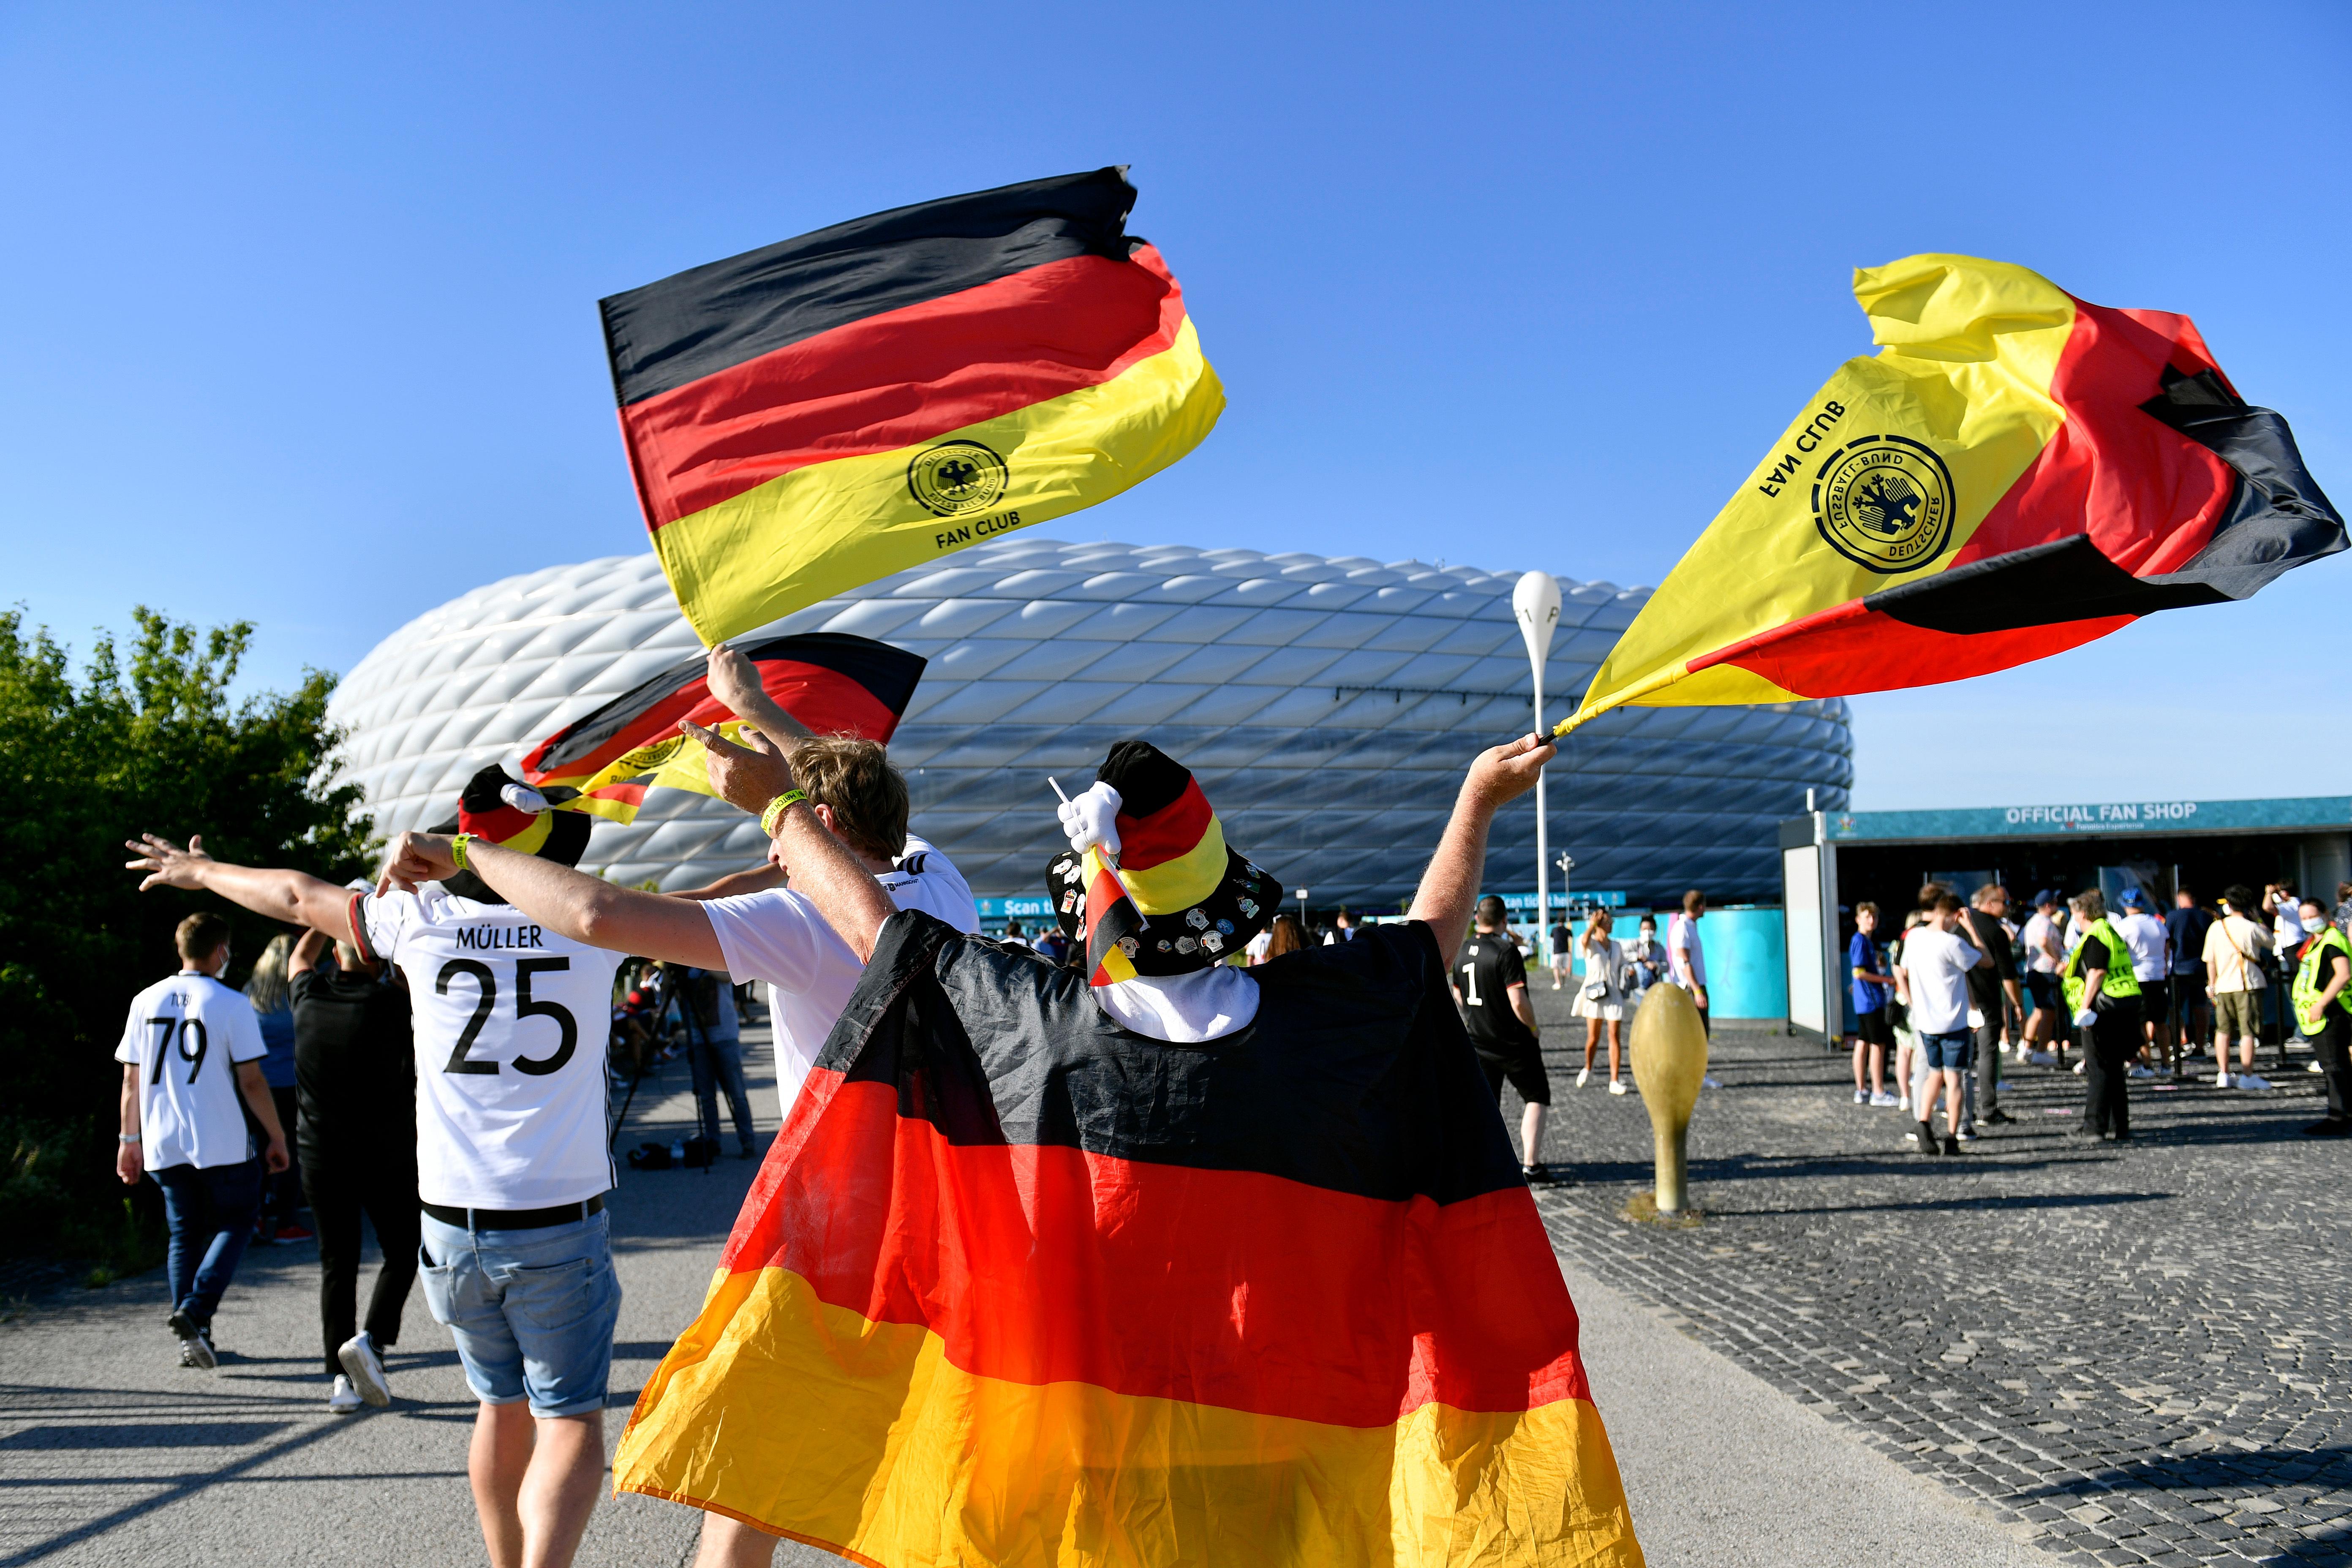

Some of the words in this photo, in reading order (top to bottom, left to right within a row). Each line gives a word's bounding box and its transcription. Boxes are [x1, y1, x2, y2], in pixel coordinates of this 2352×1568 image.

[936, 526, 971, 549] FAN
[975, 511, 1020, 535] CLUB
[769, 807, 776, 815] 12
[775, 793, 796, 808] MATCH
[2007, 805, 2094, 824] OFFICIAL
[2100, 804, 2137, 821] FAN
[2143, 802, 2197, 819] SHOP
[1004, 900, 1040, 915] Scan
[456, 924, 543, 949] MÜLLER
[1462, 962, 1483, 1006] 1
[436, 956, 577, 1075] 25
[146, 1018, 207, 1085] 79
